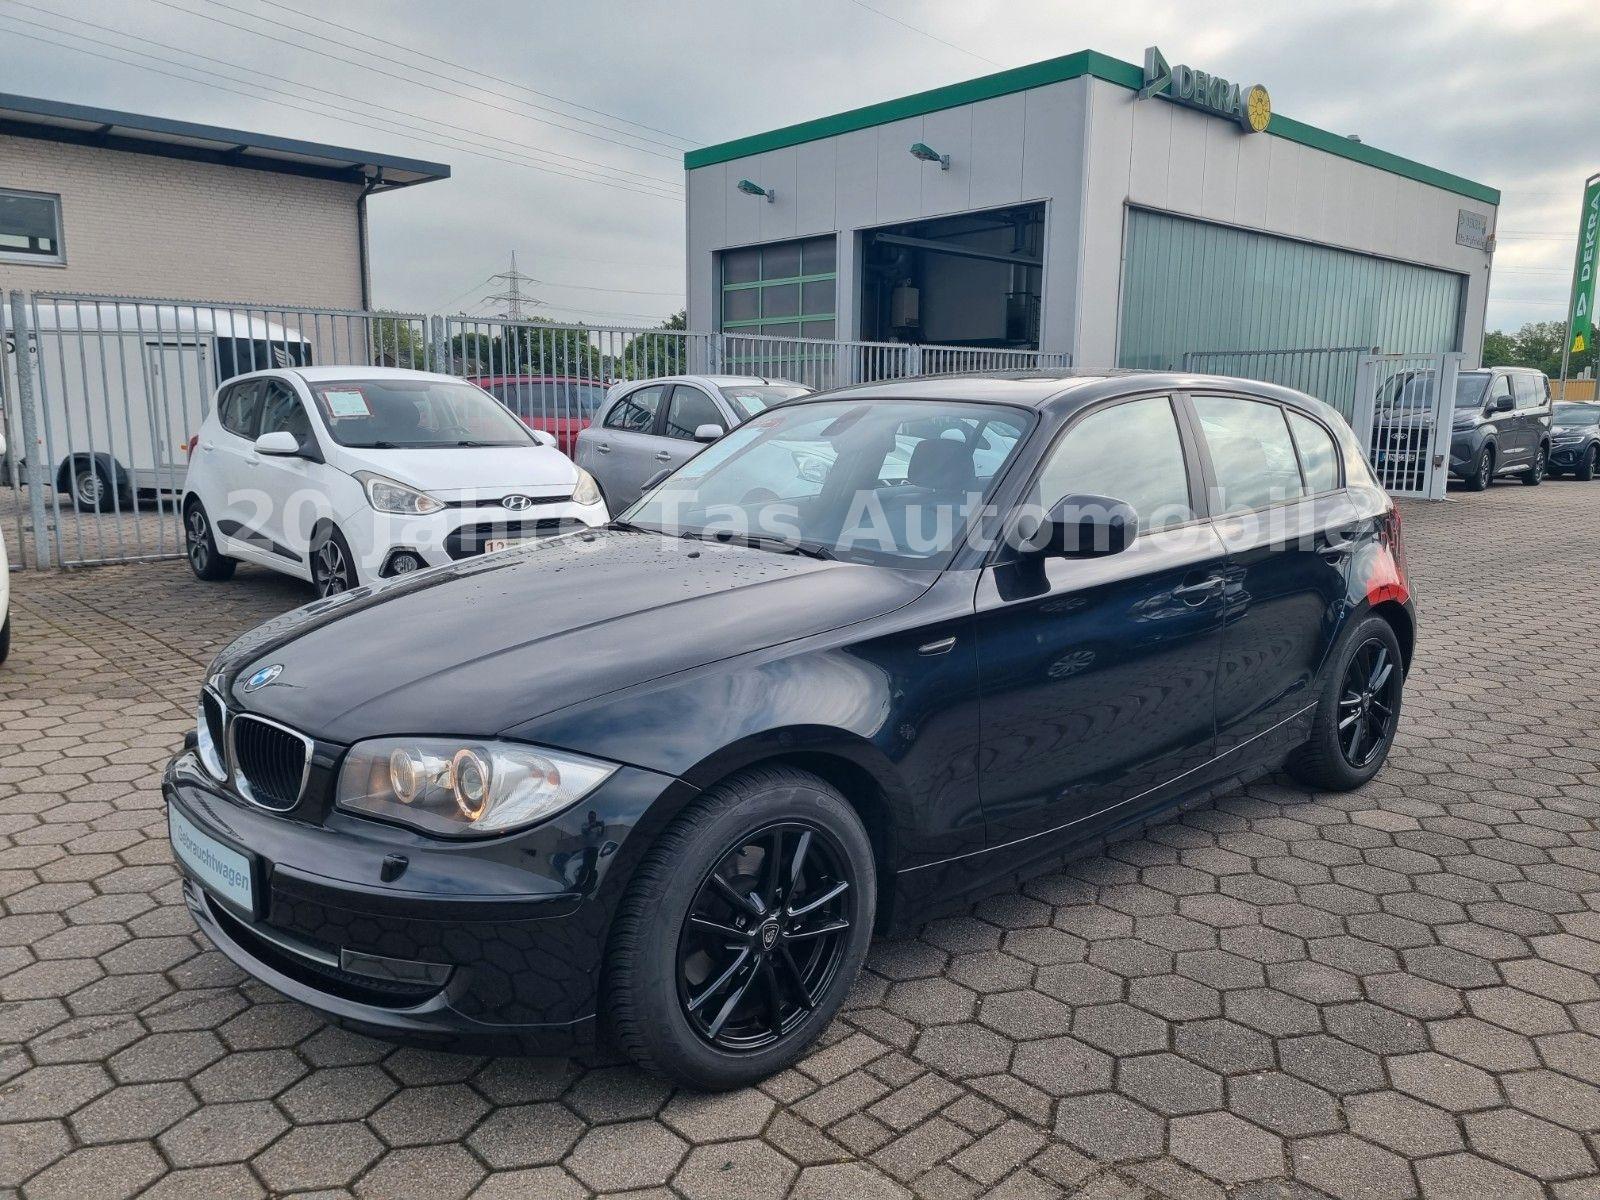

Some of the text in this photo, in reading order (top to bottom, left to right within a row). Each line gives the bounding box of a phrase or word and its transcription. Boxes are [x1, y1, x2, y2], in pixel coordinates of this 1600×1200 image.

[1172, 64, 1243, 119] DEKRA
[1581, 191, 1600, 281] DEKRA
[178, 825, 250, 891] Gebrauchtwagen
